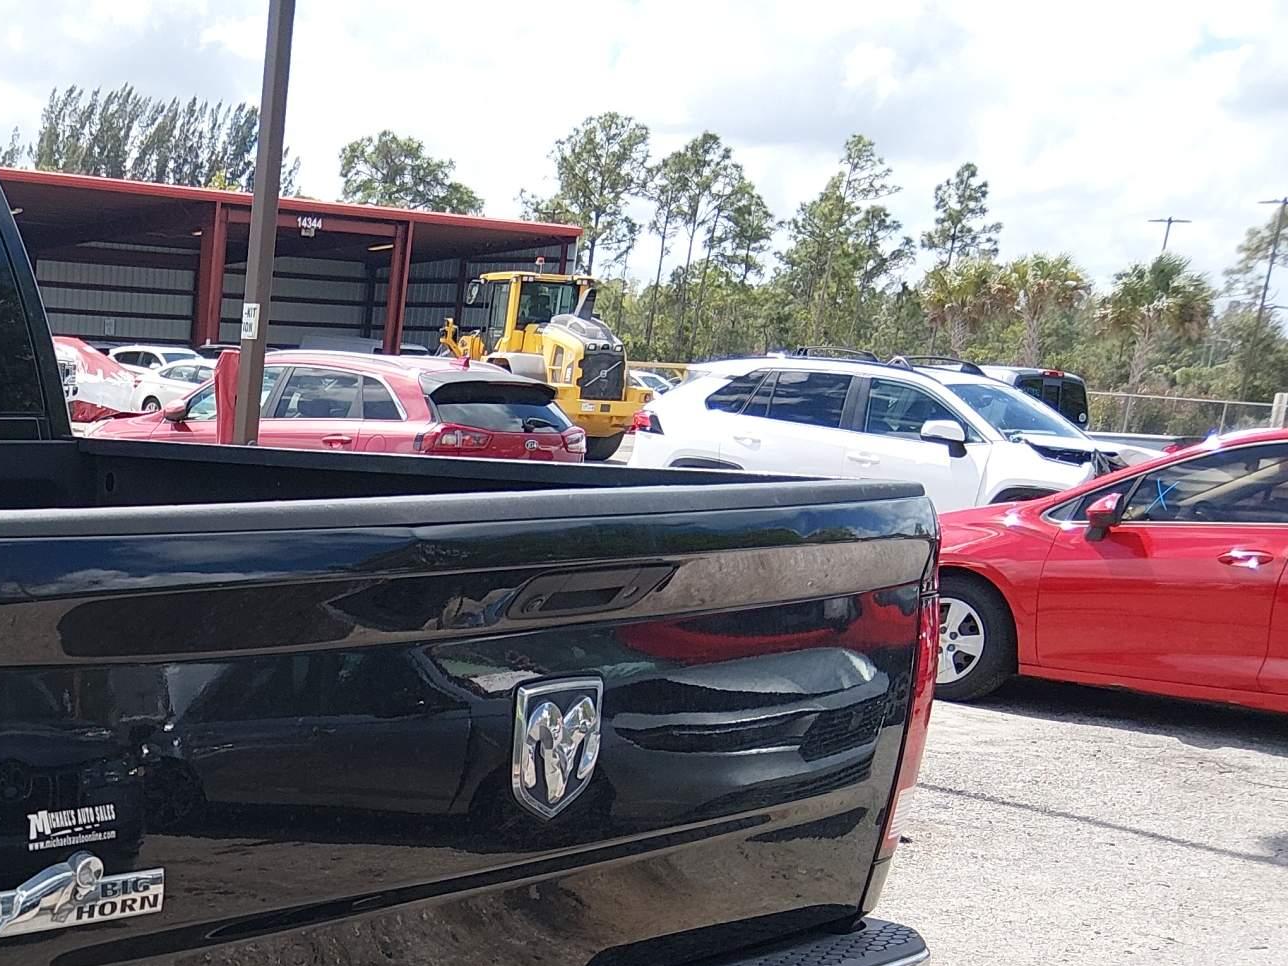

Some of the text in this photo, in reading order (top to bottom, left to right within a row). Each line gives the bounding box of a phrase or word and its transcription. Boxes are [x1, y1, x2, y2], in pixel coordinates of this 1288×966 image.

[297, 216, 322, 229] 14344
[77, 807, 95, 825] AUTO
[94, 803, 116, 822] SALES
[101, 878, 151, 897] BIG
[76, 894, 159, 920] HORN
